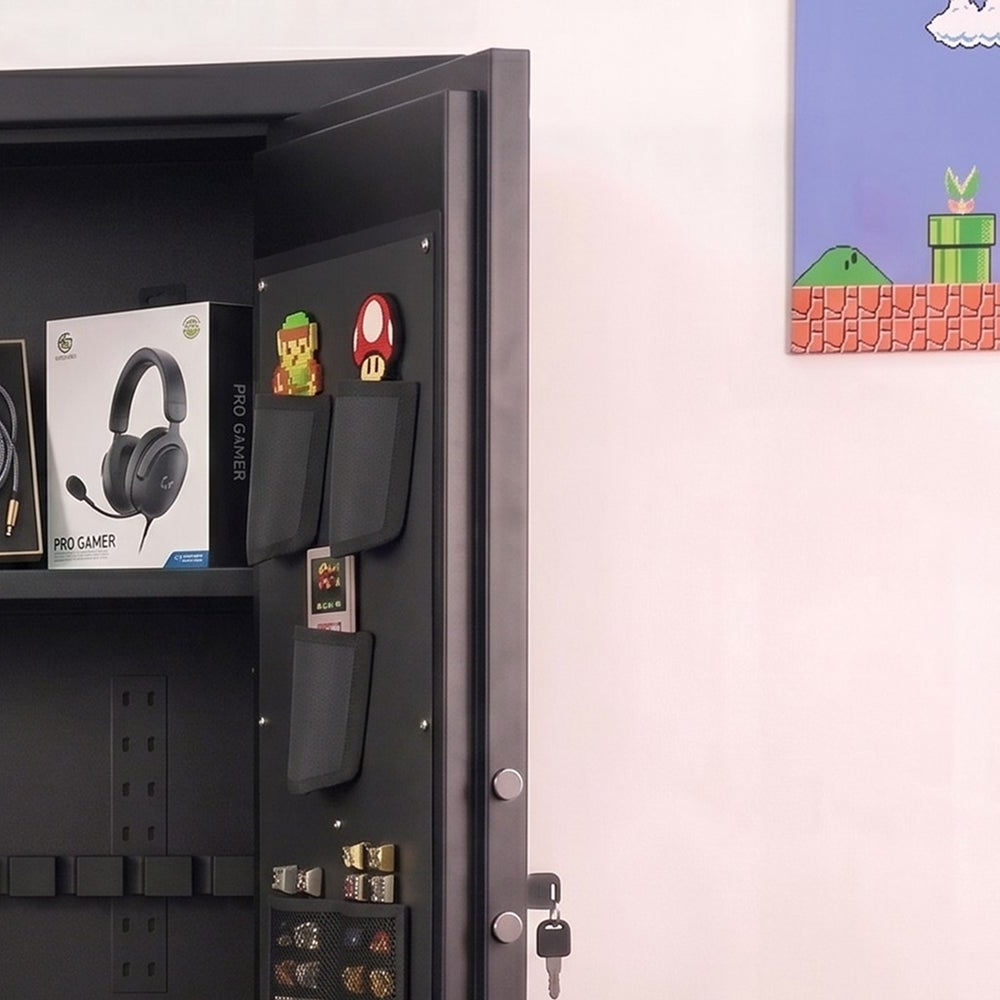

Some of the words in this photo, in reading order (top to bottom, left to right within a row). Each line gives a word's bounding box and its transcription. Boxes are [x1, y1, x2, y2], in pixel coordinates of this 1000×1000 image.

[233, 384, 247, 417] PRO
[233, 423, 246, 481] GAMER
[53, 536, 75, 551] PRO
[77, 534, 116, 550] GAMER
